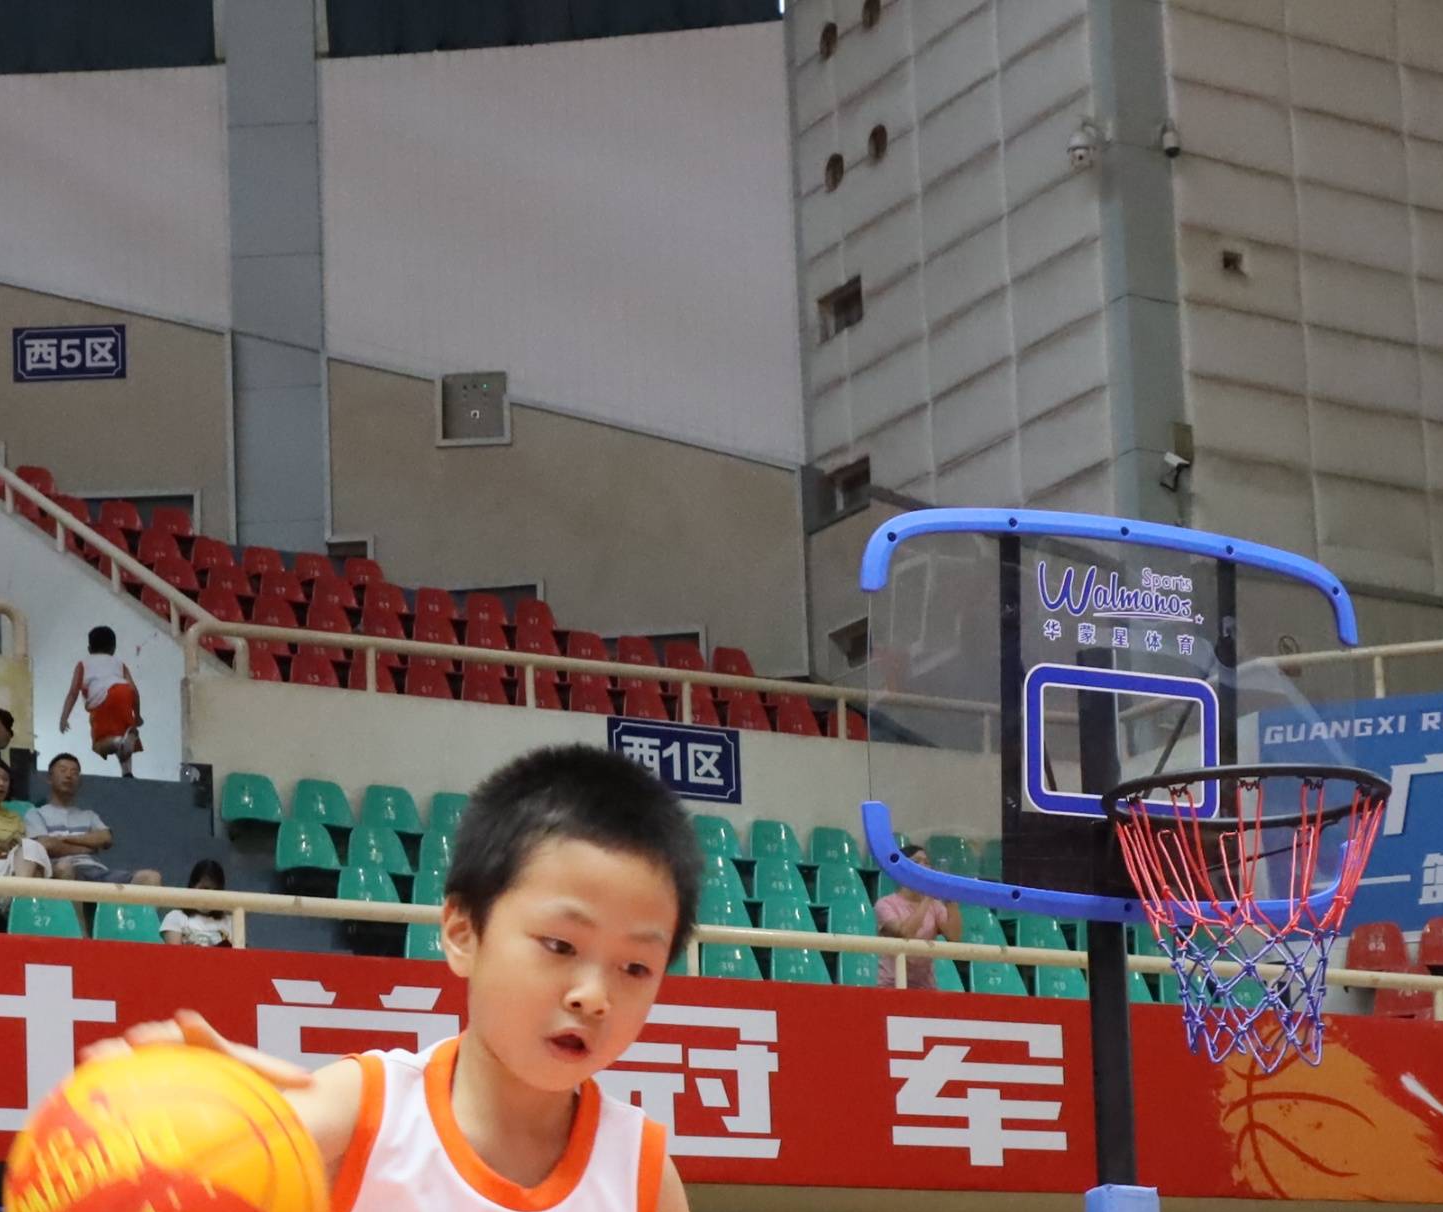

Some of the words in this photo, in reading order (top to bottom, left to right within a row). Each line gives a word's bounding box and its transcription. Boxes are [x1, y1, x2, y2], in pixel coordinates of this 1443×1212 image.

[24, 336, 116, 371] 西5区
[1038, 561, 1192, 617] Walmonos
[1142, 567, 1193, 592] Sports
[1044, 618, 1194, 655] 华蒙星体育
[1264, 714, 1406, 745] GUANGXI
[621, 735, 724, 785] 西1区
